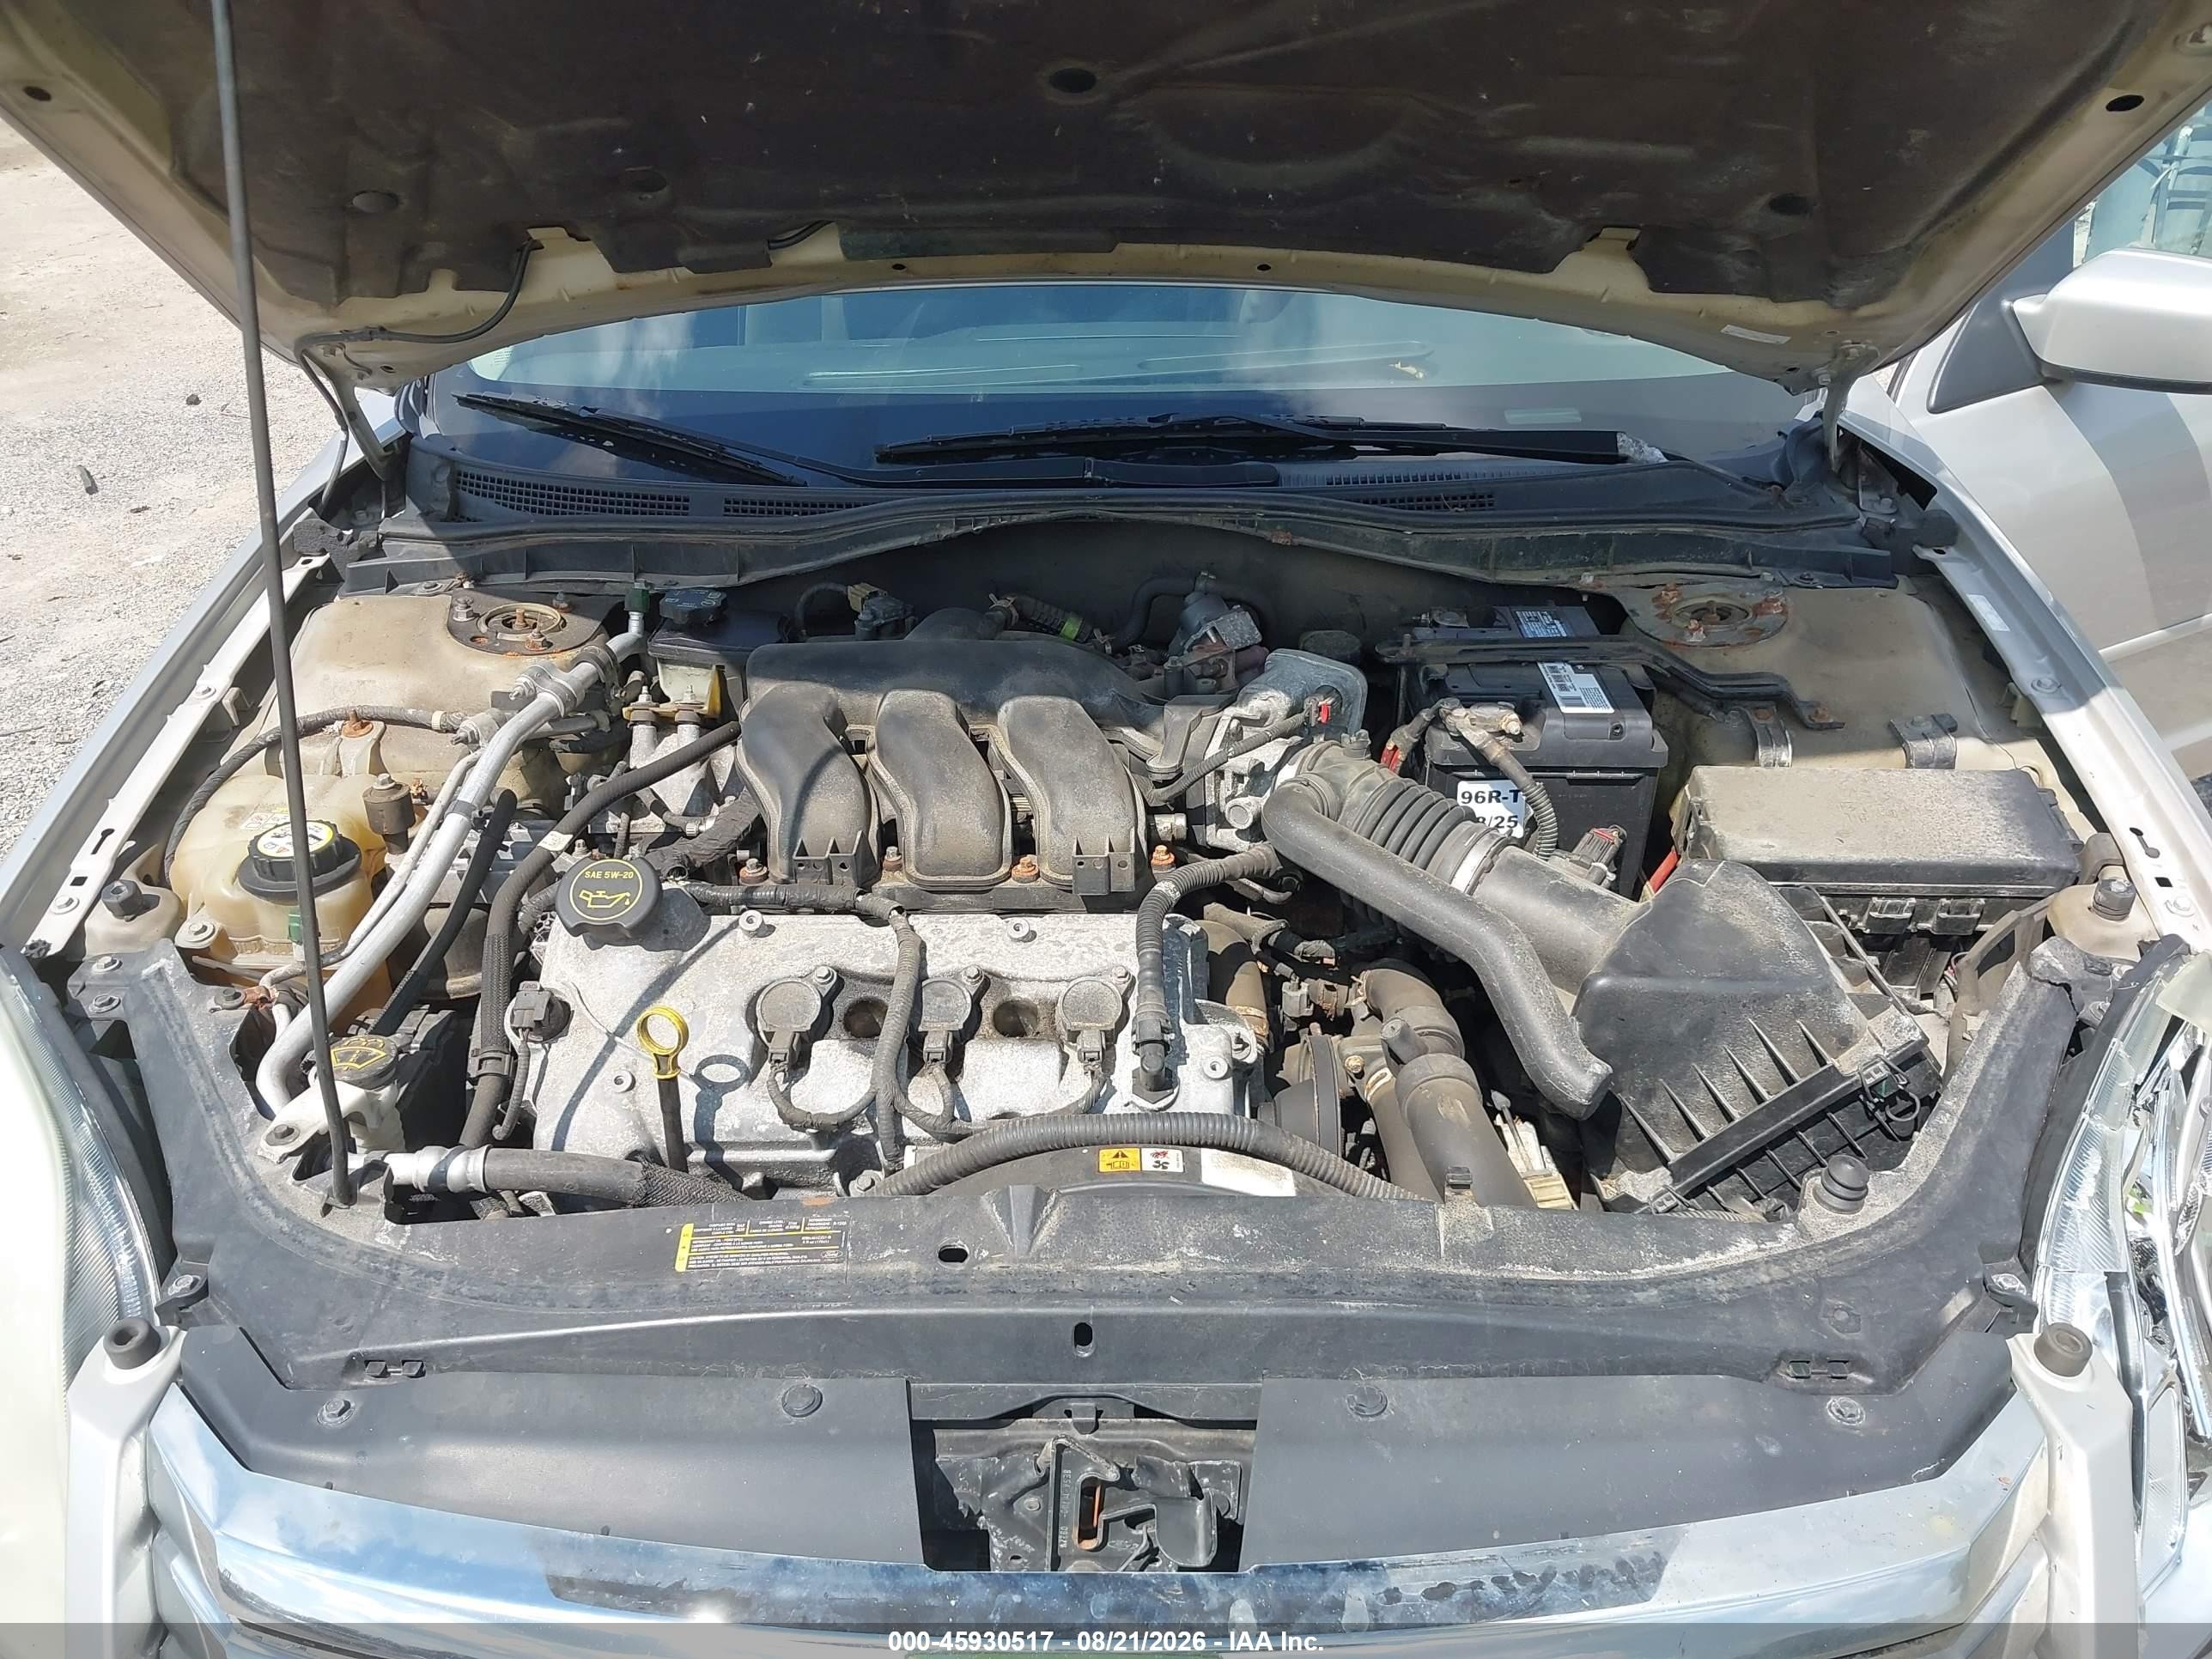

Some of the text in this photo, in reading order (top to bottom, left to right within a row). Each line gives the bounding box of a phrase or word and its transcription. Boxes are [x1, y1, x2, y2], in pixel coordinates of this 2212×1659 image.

[1461, 789, 1521, 805] 96R-T
[584, 871, 634, 879] SAE 5W-20
